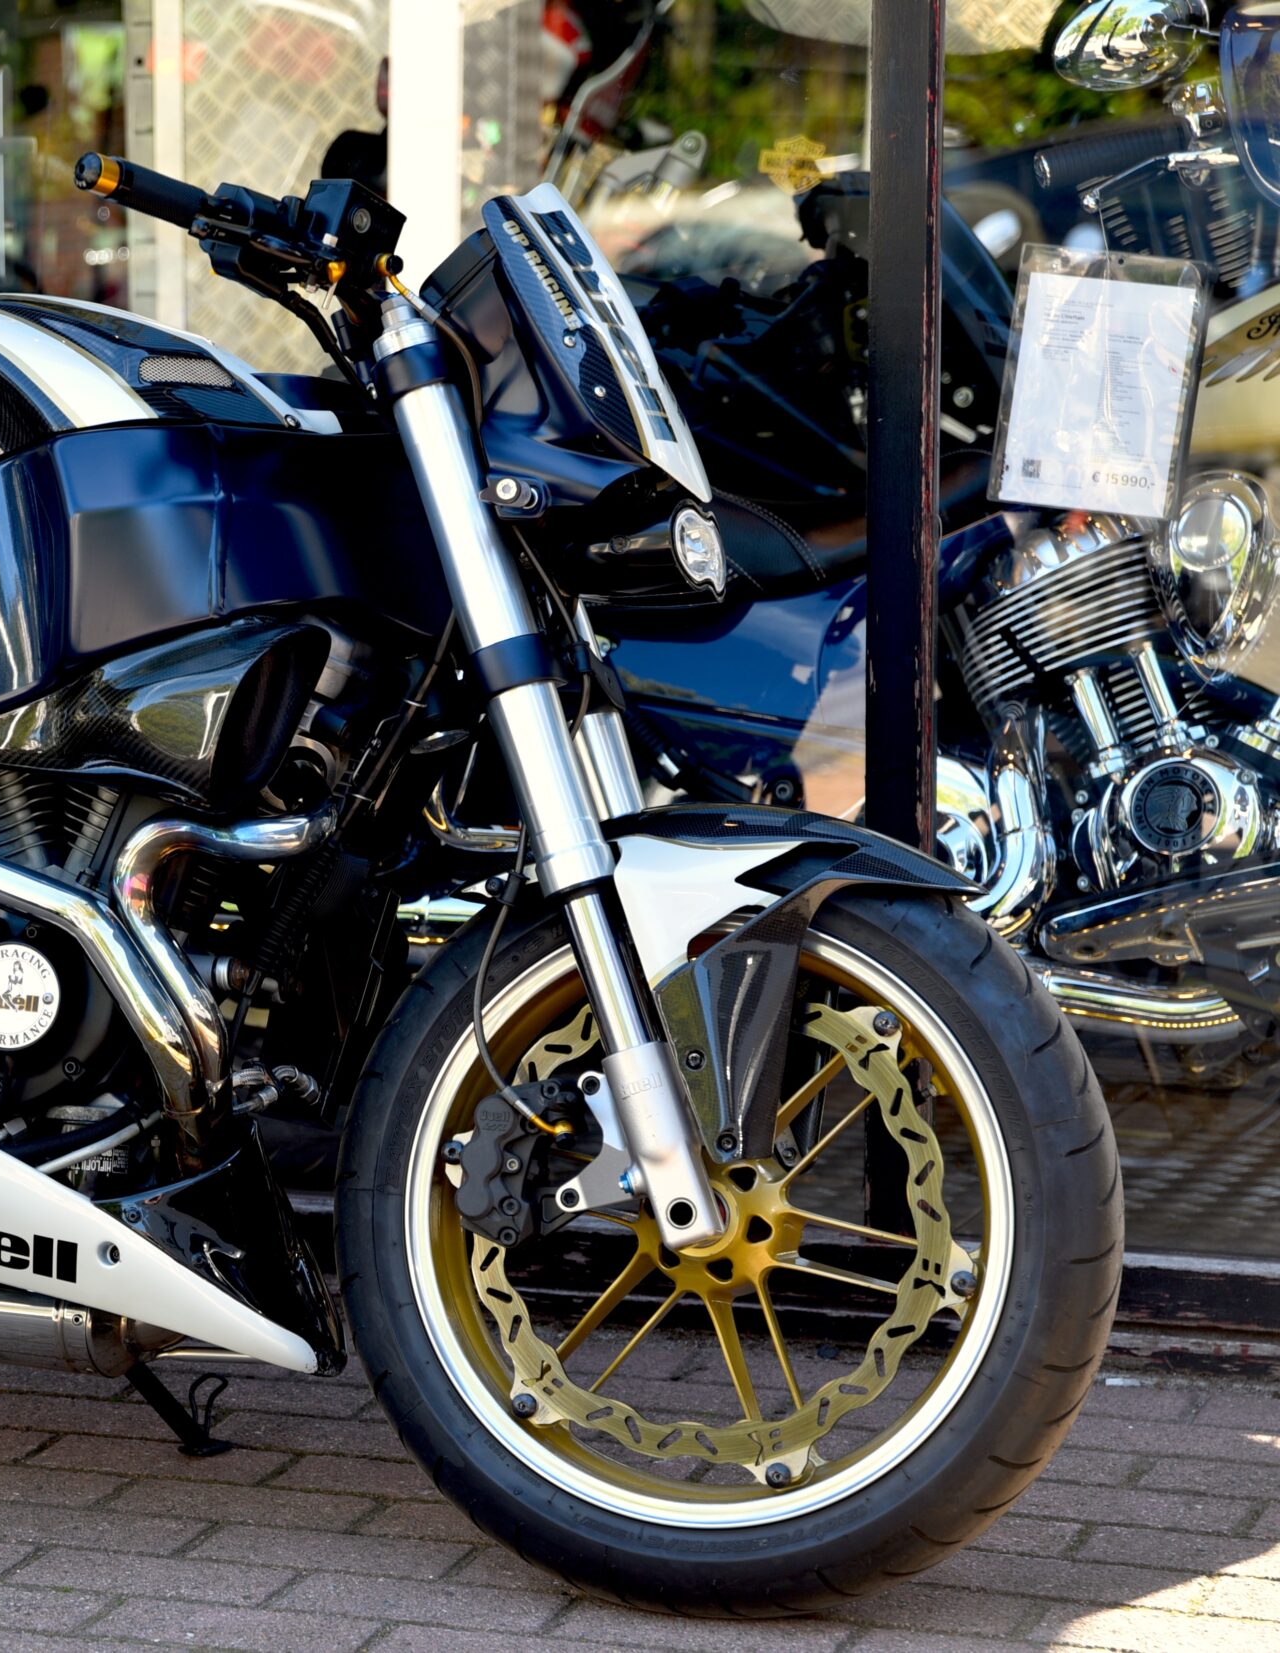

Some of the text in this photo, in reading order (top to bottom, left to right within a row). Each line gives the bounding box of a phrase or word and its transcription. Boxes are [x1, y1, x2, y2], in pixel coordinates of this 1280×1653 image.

[502, 220, 580, 331] OP RACING
[0, 949, 50, 979] RACING
